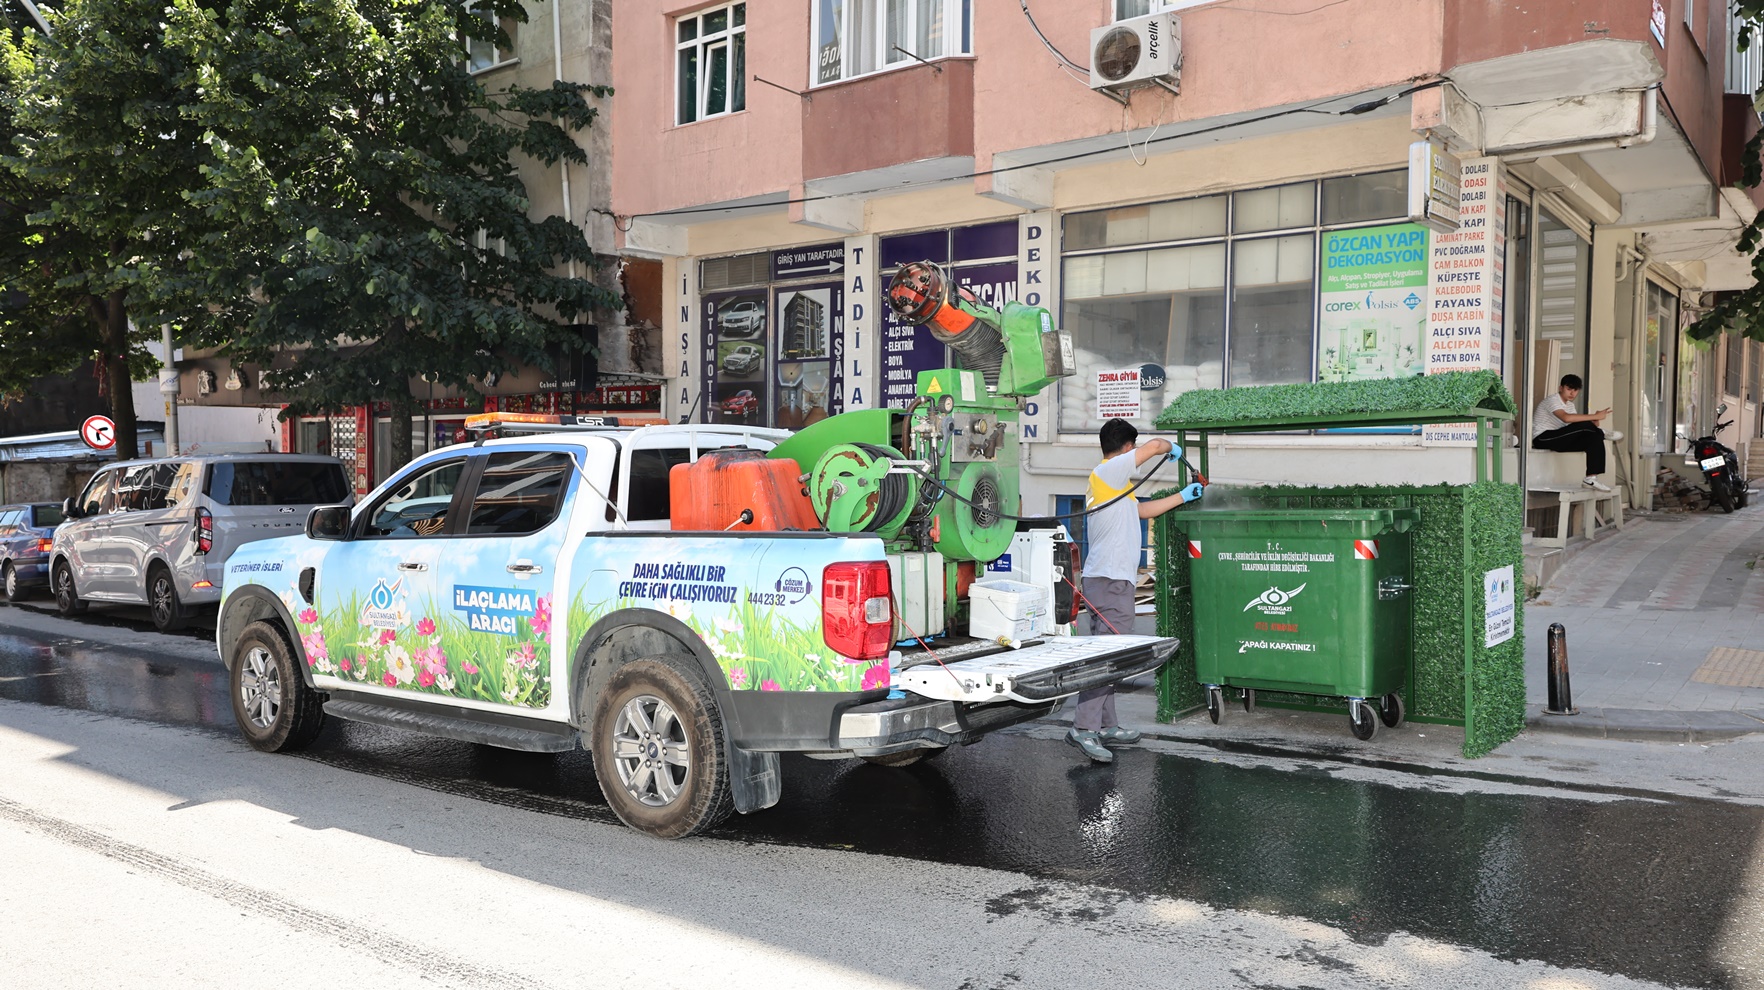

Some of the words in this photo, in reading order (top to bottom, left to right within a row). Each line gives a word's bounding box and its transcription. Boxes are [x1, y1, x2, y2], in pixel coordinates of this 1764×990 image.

[1149, 20, 1159, 60] arçelik
[1465, 164, 1489, 175] DOLABI
[1464, 177, 1487, 188] ODASI
[1461, 191, 1486, 202] DOLABI
[1470, 205, 1486, 214] KAPI
[1464, 218, 1486, 228] KAPI
[1328, 234, 1382, 253] ÖZCAN
[1385, 230, 1425, 248] YAPI
[1464, 231, 1485, 242] PARKE
[1434, 247, 1448, 257] PVC
[1449, 244, 1485, 256] DOĞRAMA
[777, 252, 794, 266] GİRİŞ
[793, 252, 807, 263] YAN
[807, 248, 845, 262] TARAFTADIR.
[1327, 248, 1424, 269] DEKORASYON
[1434, 260, 1451, 270] CAM
[1453, 258, 1484, 269] BALKON
[1392, 270, 1423, 278] Uygulama
[1437, 271, 1481, 283] KÜPEŞTE
[1345, 282, 1360, 290] Satış
[1369, 280, 1388, 288] Tadilat
[1435, 284, 1482, 296] KALEBODUR
[1325, 301, 1361, 312] corex
[1368, 299, 1399, 310] Polsis
[1434, 298, 1481, 309] FAYANS
[1431, 312, 1454, 324] DUŞA
[1456, 308, 1484, 320] KABİN
[851, 247, 864, 405] TADİLA
[888, 326, 901, 339] ALÇI
[901, 326, 915, 337] SIVA
[1432, 327, 1455, 338] ALÇI
[1457, 326, 1481, 336] SIVA
[888, 338, 914, 352] ELEKTRİK
[1432, 340, 1480, 351] ALÇIPAN
[888, 355, 903, 366] BOYA
[1431, 354, 1457, 363] SATEN
[1459, 353, 1481, 362] BOYA
[888, 368, 912, 381] MOBİLYA
[1098, 373, 1119, 382] ZEHRA
[1119, 371, 1138, 381] GİYİM
[887, 384, 913, 395] ANAHTAR
[576, 416, 605, 426] CSR
[1425, 432, 1434, 443] DIŞ
[1434, 432, 1450, 441] CEPHE
[1451, 432, 1478, 441] MANTOLAM
[633, 563, 659, 580] DAHA
[661, 561, 708, 581] SAĞLIKLI
[1241, 563, 1269, 571] TARAFINDAN
[619, 581, 647, 600] ÇEVRE
[670, 583, 738, 604] ÇALIŞIYORUZ
[470, 613, 516, 634] ARACI
[1269, 642, 1311, 651] KAPATINIZ
